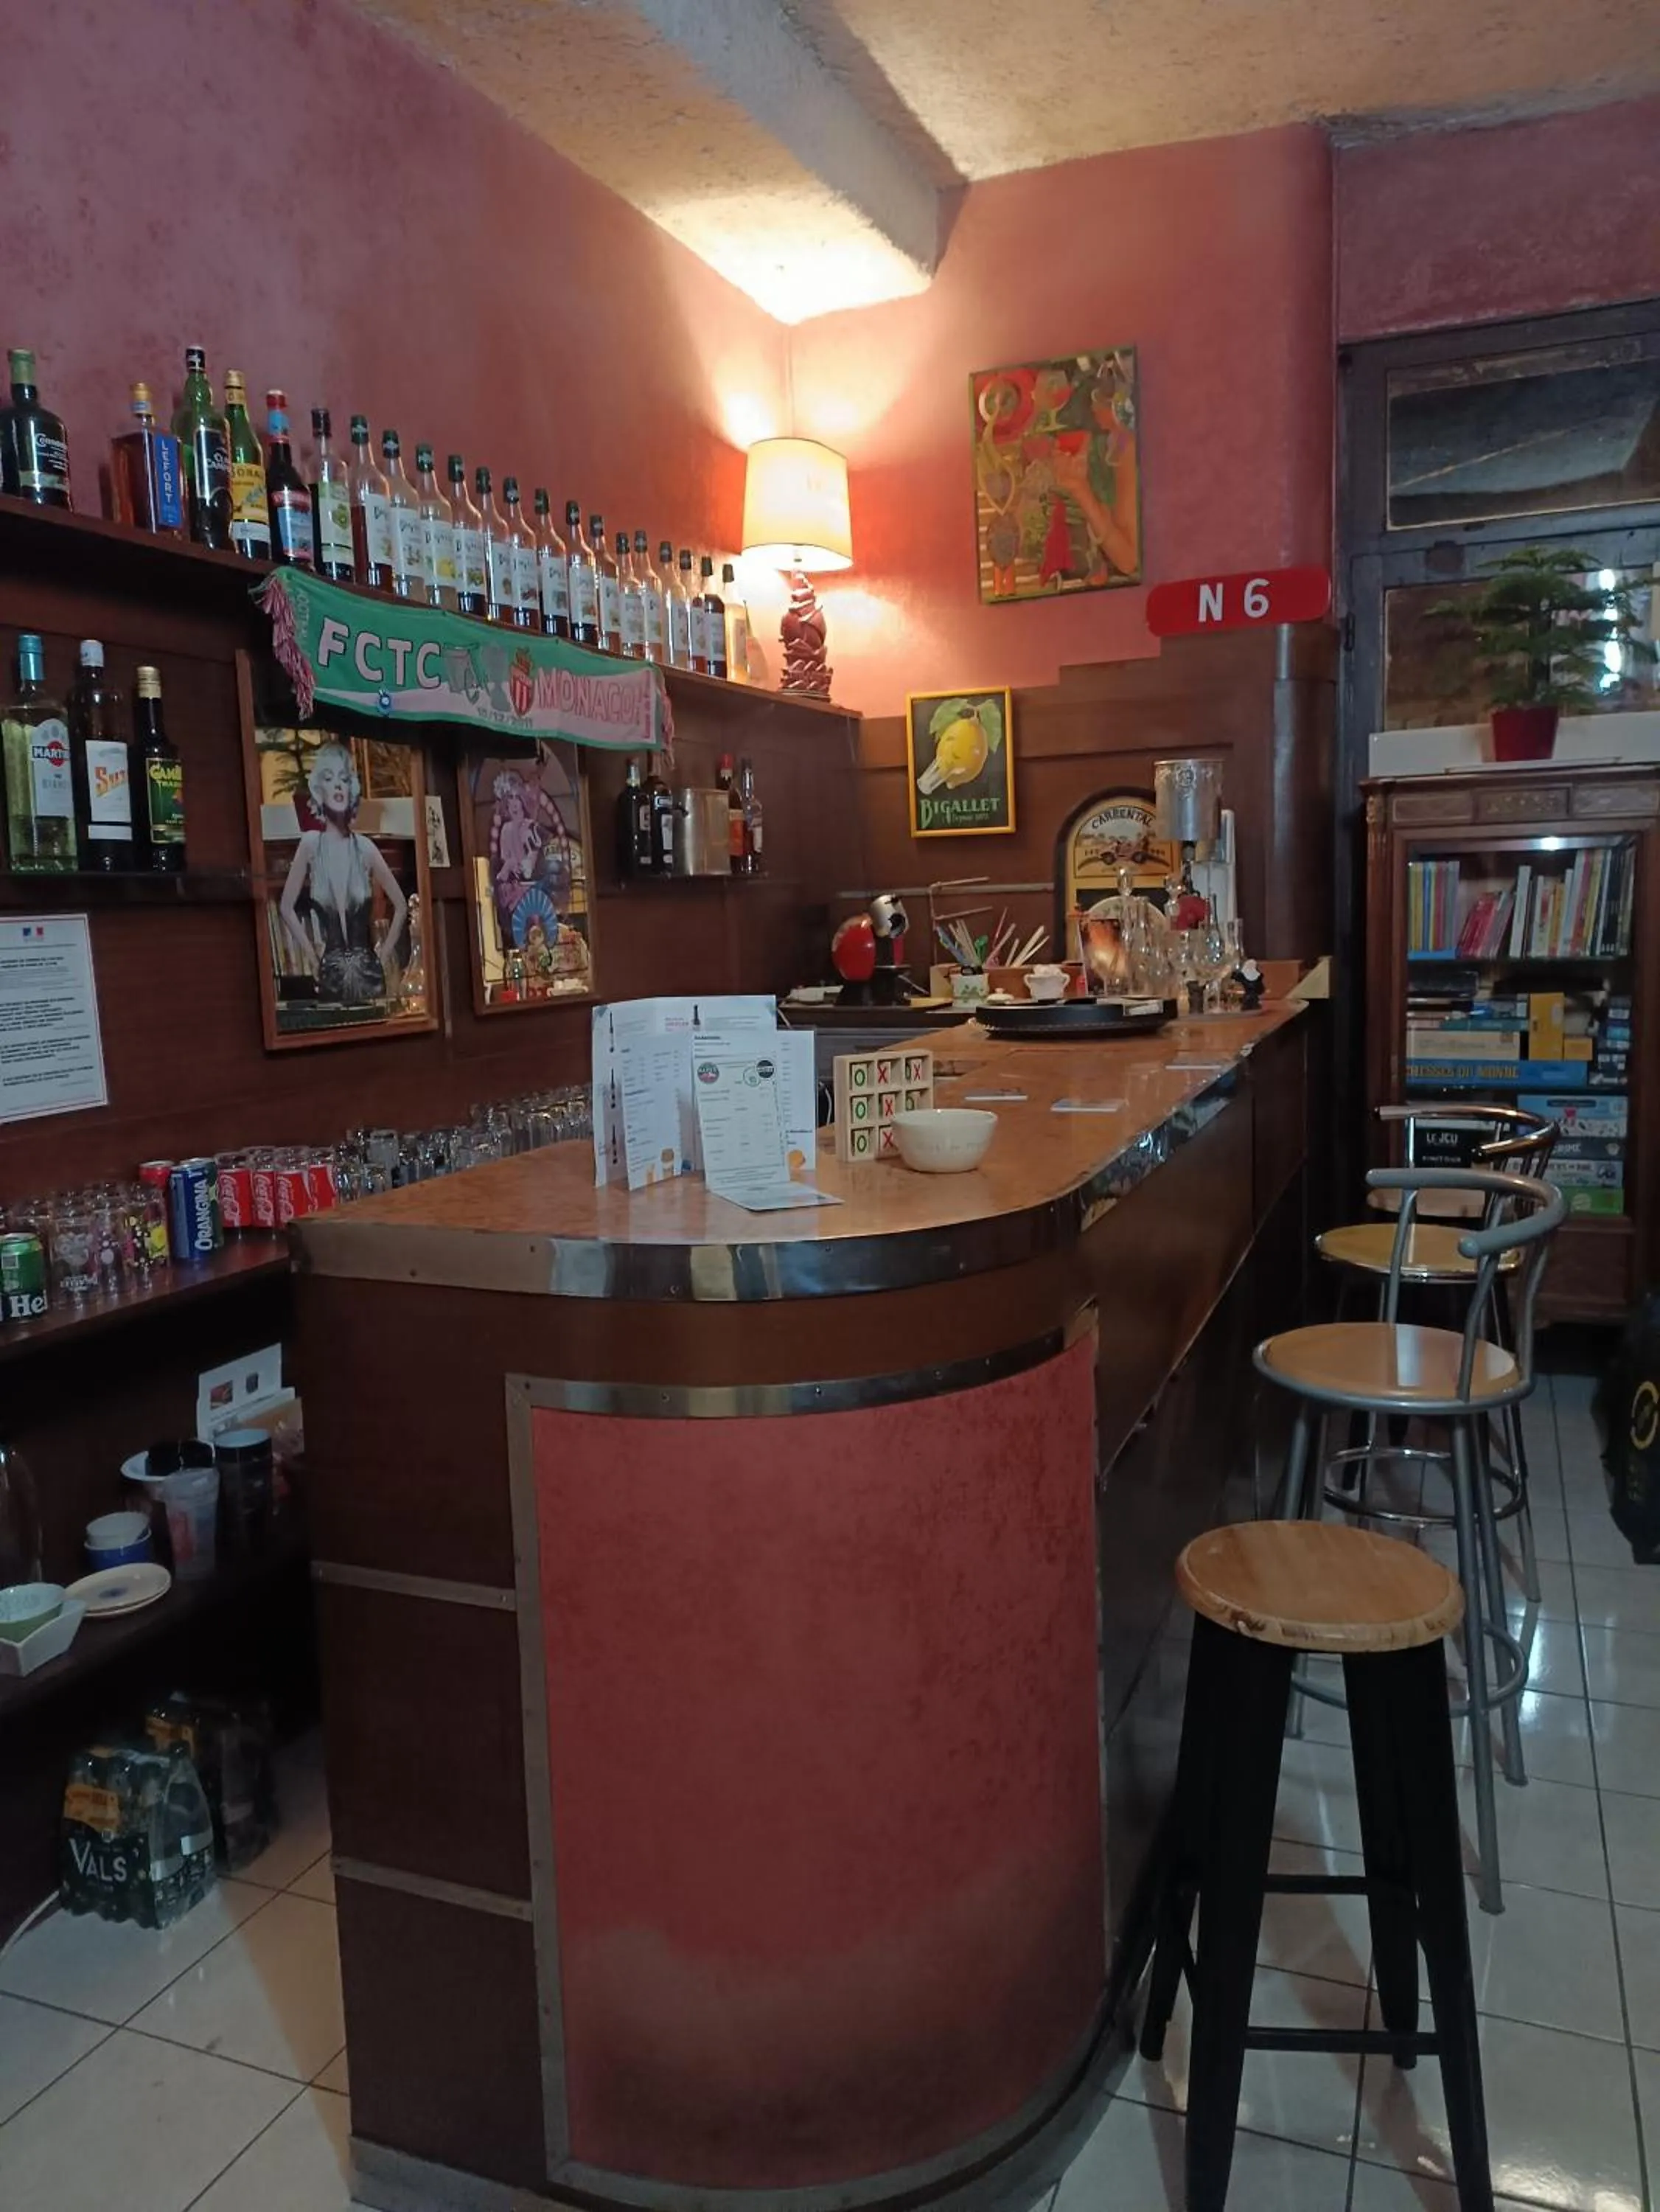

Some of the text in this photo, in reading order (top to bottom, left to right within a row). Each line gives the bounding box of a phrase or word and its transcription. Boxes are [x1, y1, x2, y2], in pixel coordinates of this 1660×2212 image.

[161, 439, 175, 504] LEFORT
[1198, 578, 1269, 623] N 6
[317, 615, 442, 689] FCTC
[34, 747, 70, 761] MARTI
[920, 798, 1000, 829] BIGALLET
[194, 1179, 214, 1251] ORANGINA
[69, 1837, 128, 1882] VALS
